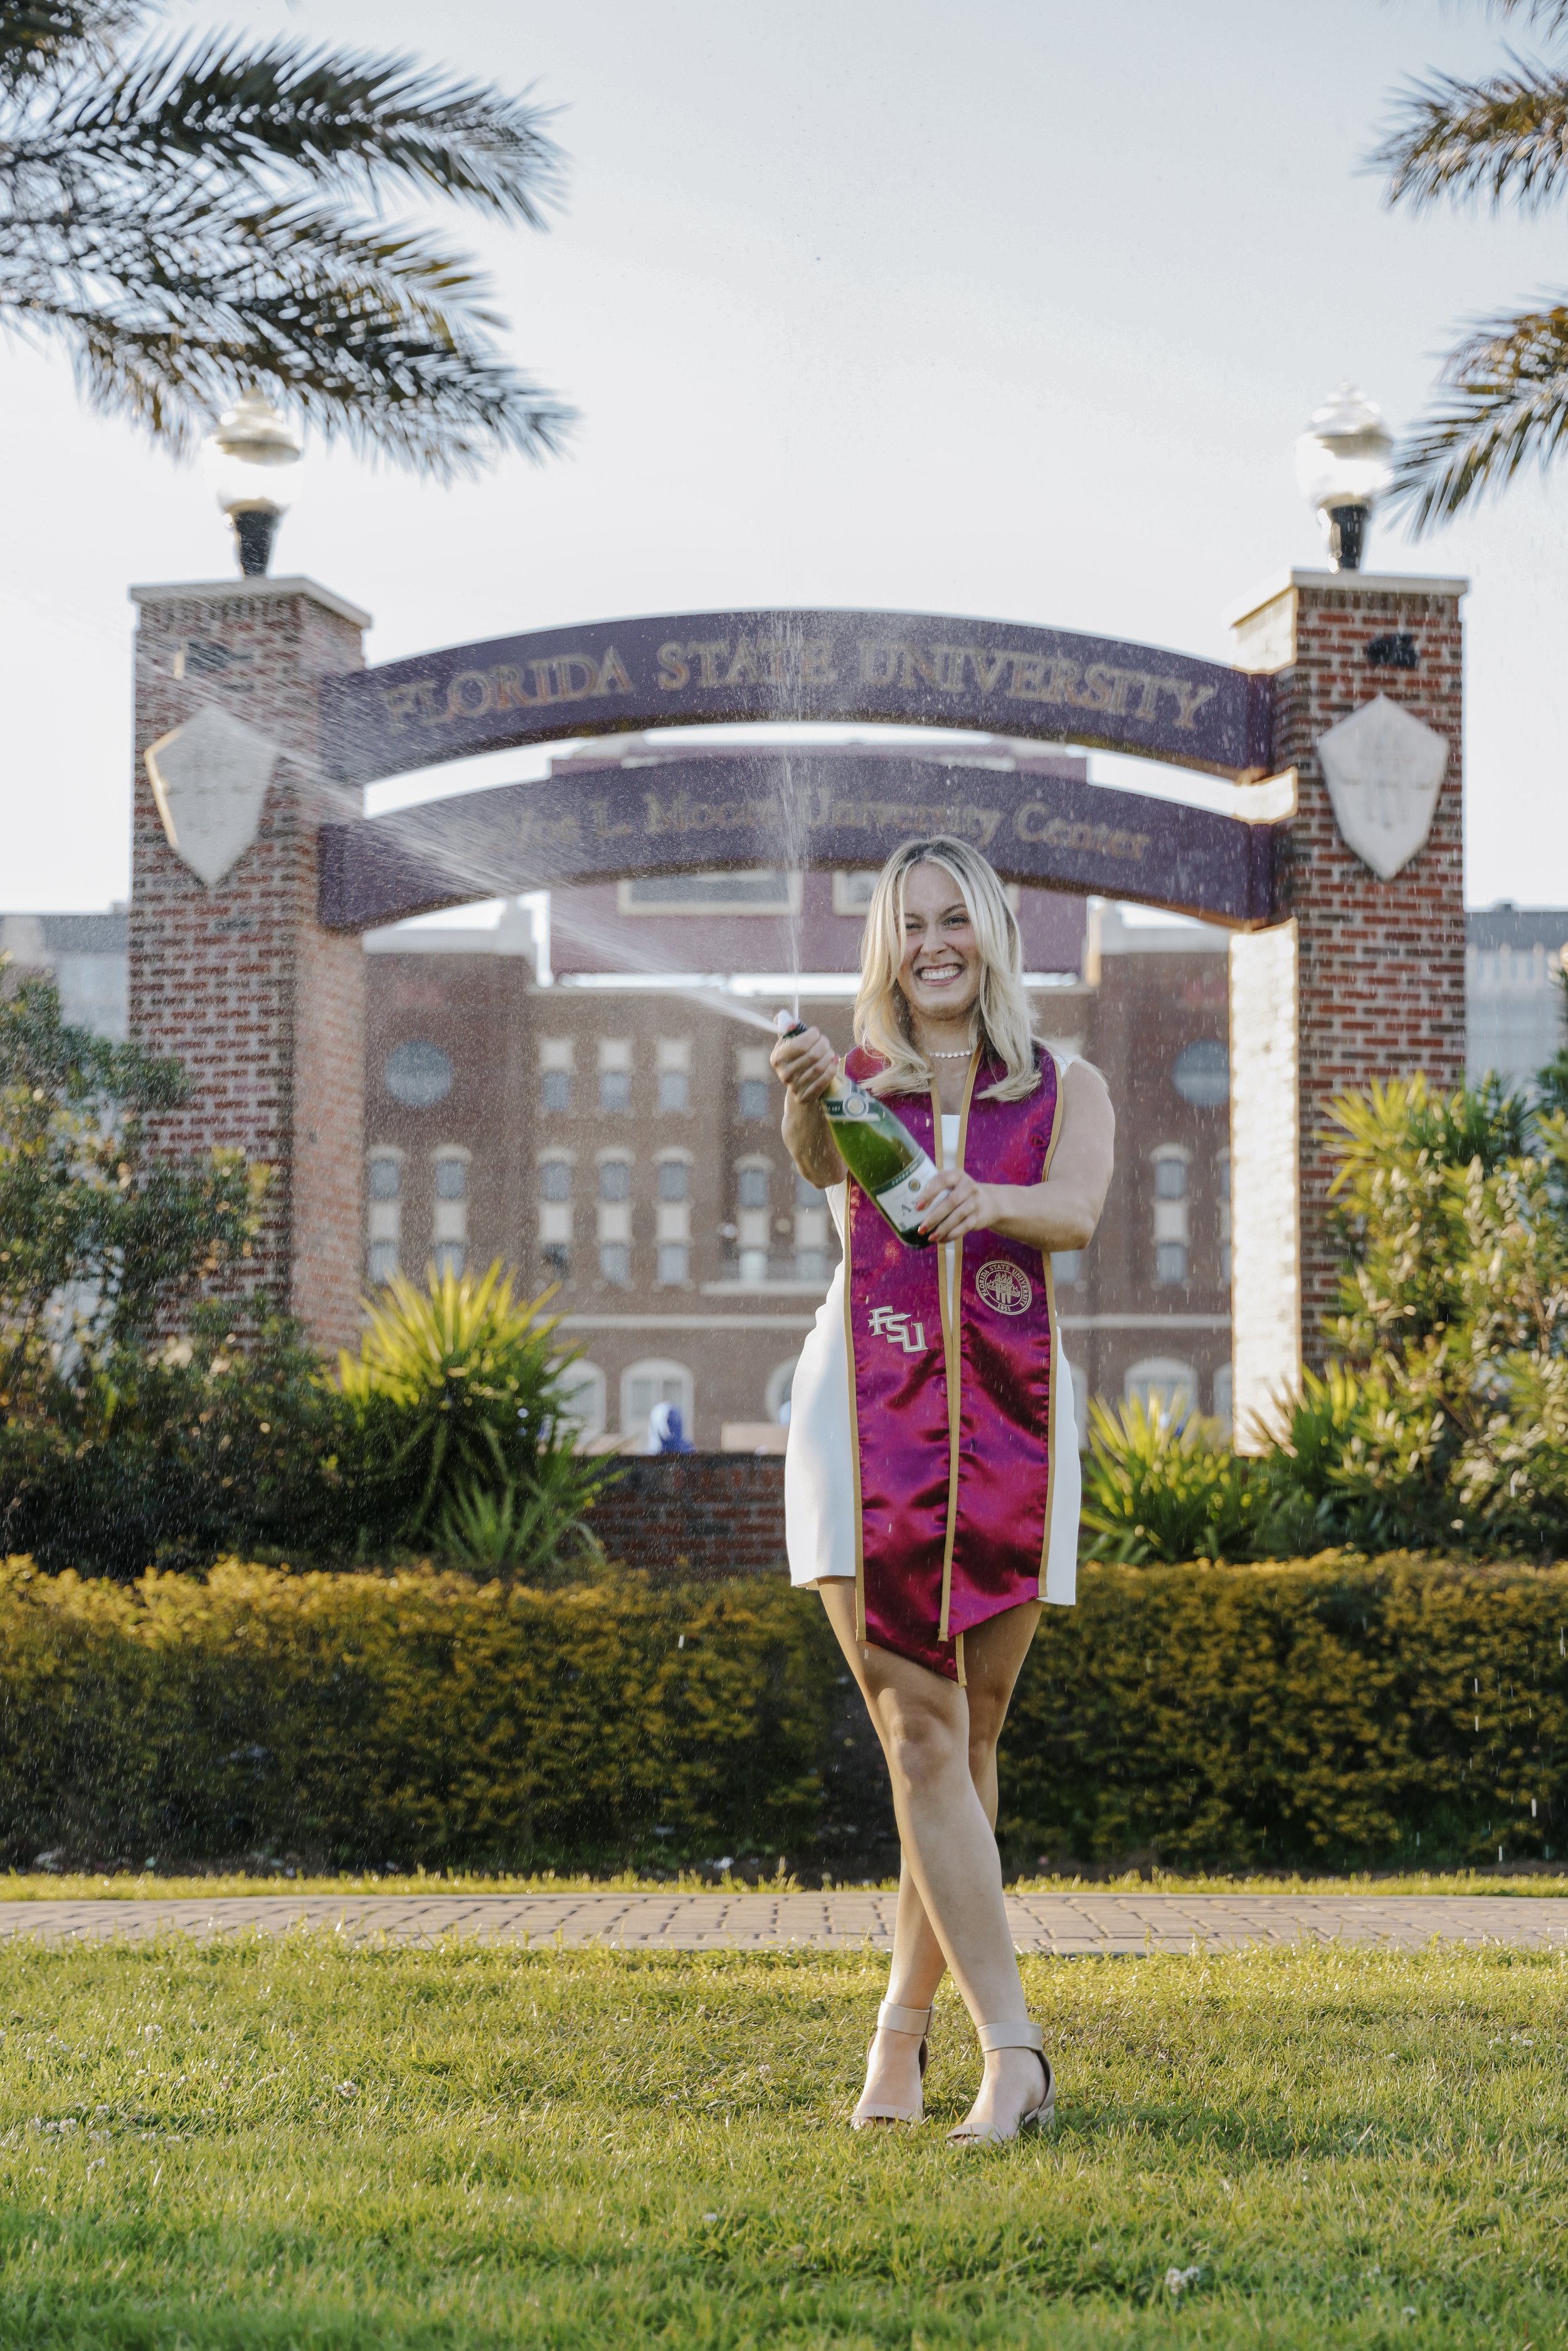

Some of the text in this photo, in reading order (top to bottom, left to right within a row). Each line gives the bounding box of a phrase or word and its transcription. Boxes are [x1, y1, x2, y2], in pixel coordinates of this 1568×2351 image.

[380, 634, 1217, 736] FLORIDA STATE UNIVERSITY
[1012, 800, 1154, 861] Center
[979, 1269, 990, 1297] FLORIDA
[1012, 1269, 1029, 1307] UNIVERSITY
[867, 1305, 929, 1353] FSU
